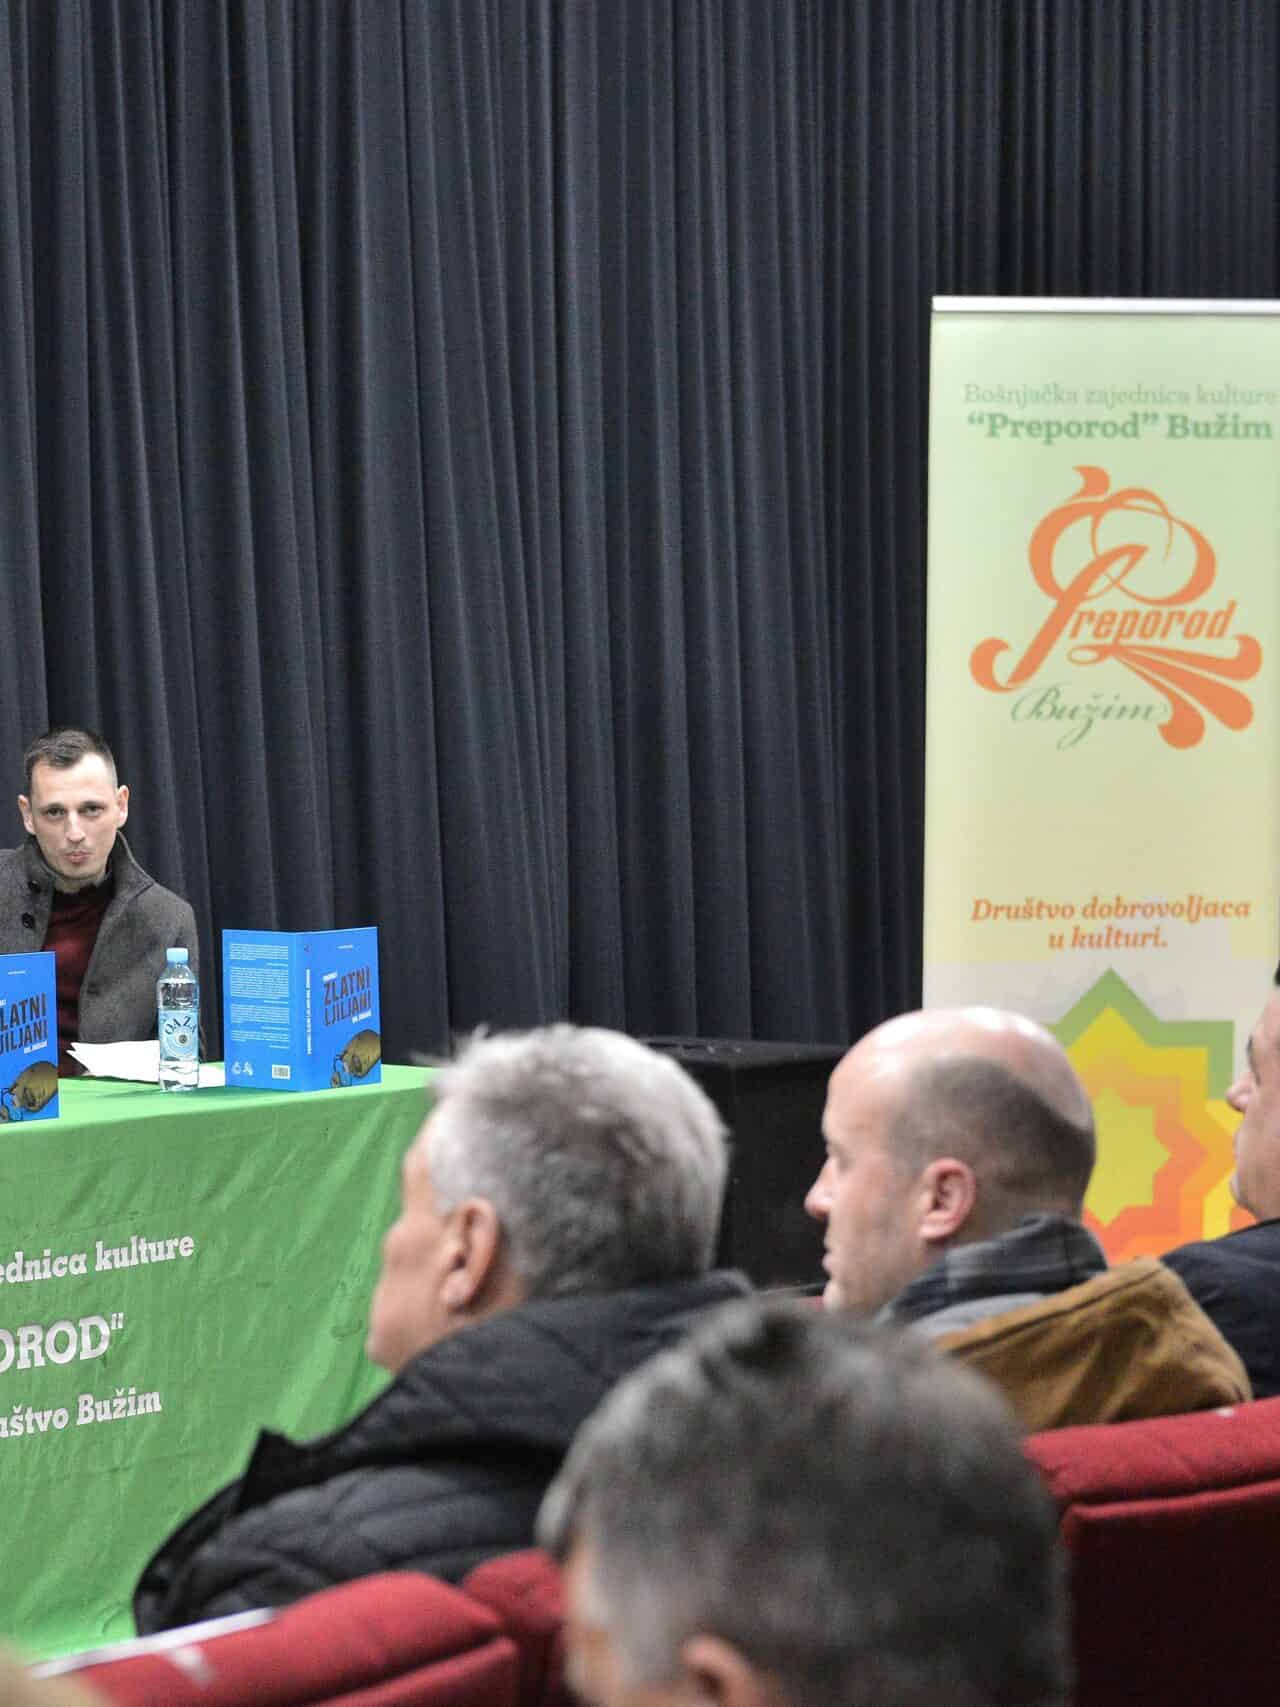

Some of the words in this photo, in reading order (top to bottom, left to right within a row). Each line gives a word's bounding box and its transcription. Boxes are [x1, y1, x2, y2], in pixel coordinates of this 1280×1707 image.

[963, 382, 1079, 408] Bošnjačka
[1084, 382, 1190, 409] zajednica
[1196, 384, 1277, 405] kulture
[1167, 411, 1274, 440] Bužim
[1010, 683, 1169, 751] Bužim
[971, 897, 1075, 921] Društvo
[1081, 895, 1251, 923] dobrovoljaca
[1048, 932, 1064, 949] u
[1072, 926, 1168, 949] kulturi.
[323, 965, 370, 1005] ZLATNI
[324, 990, 372, 1027] LJILJANI
[95, 1235, 195, 1271] kulture
[76, 1388, 162, 1426] Bužim
